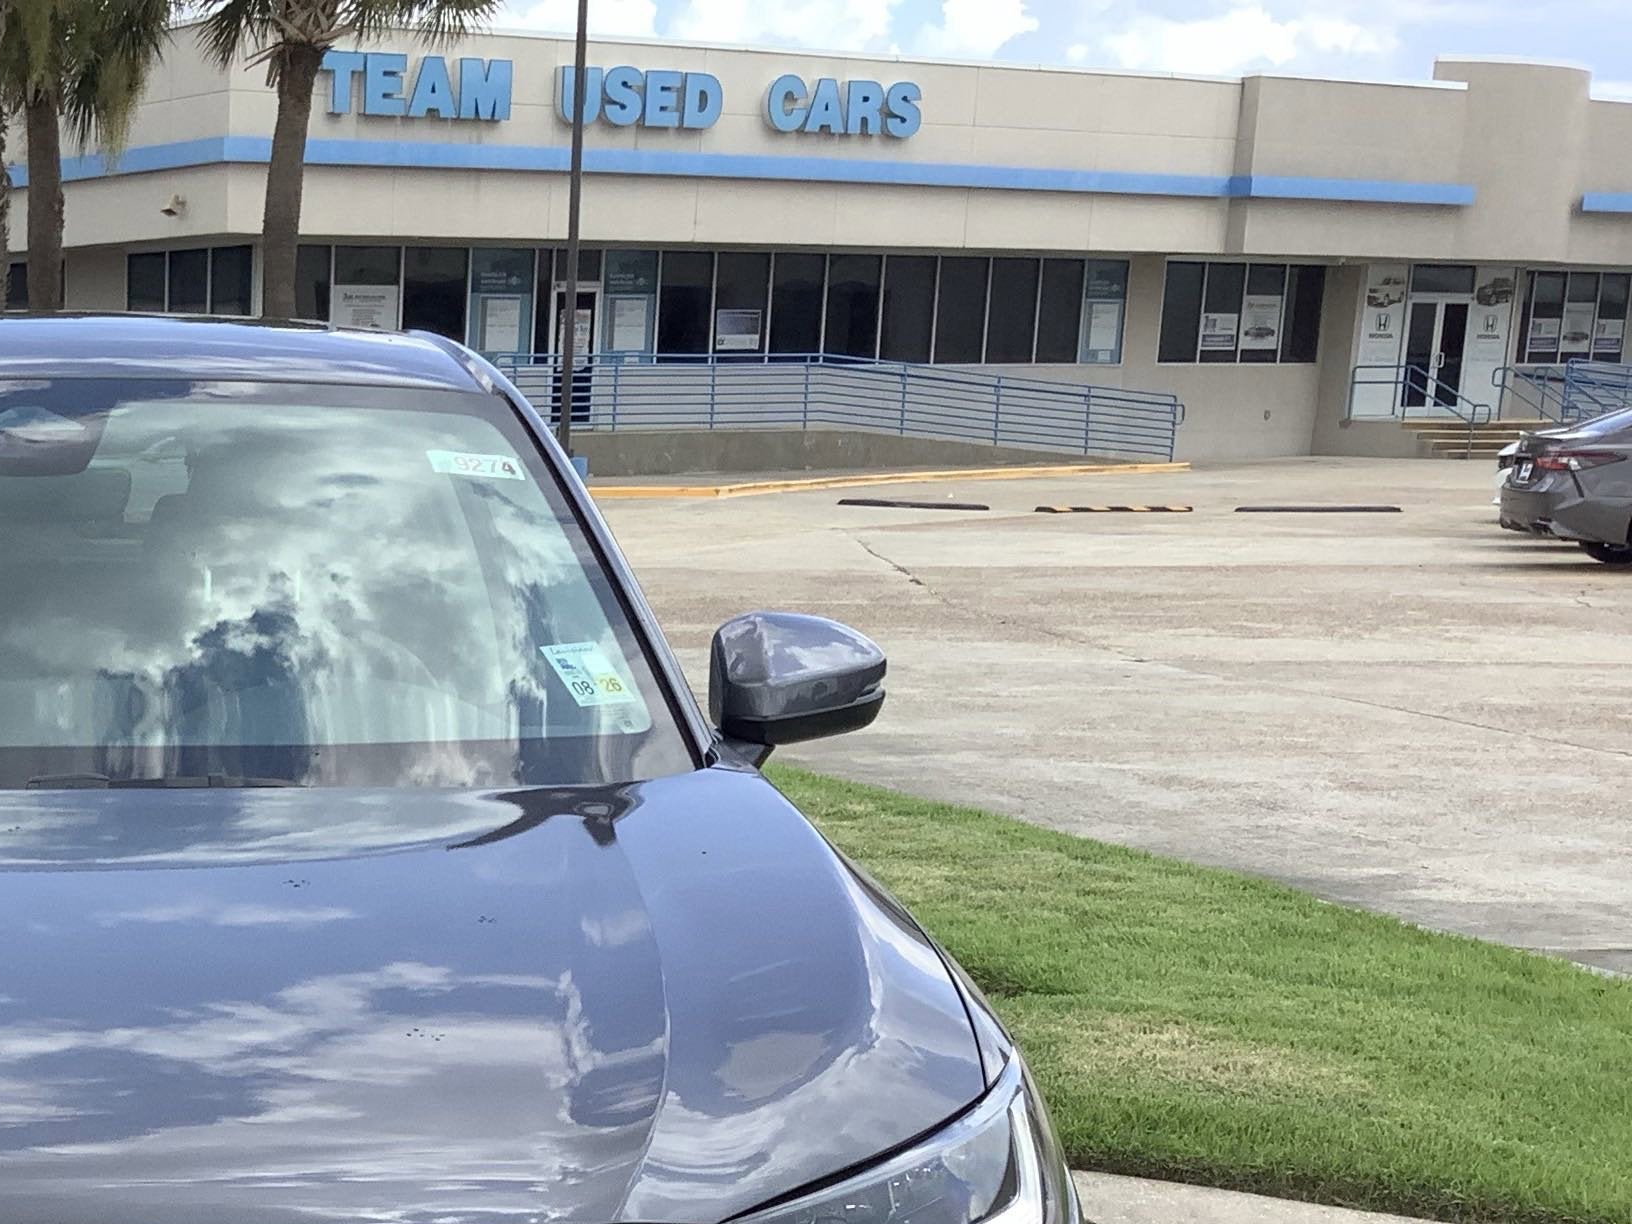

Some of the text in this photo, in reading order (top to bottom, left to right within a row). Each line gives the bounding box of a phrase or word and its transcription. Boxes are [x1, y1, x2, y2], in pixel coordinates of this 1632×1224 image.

[322, 50, 921, 138] TEAM USED CARS
[454, 456, 516, 475] 9274
[571, 677, 622, 696] 08 26
